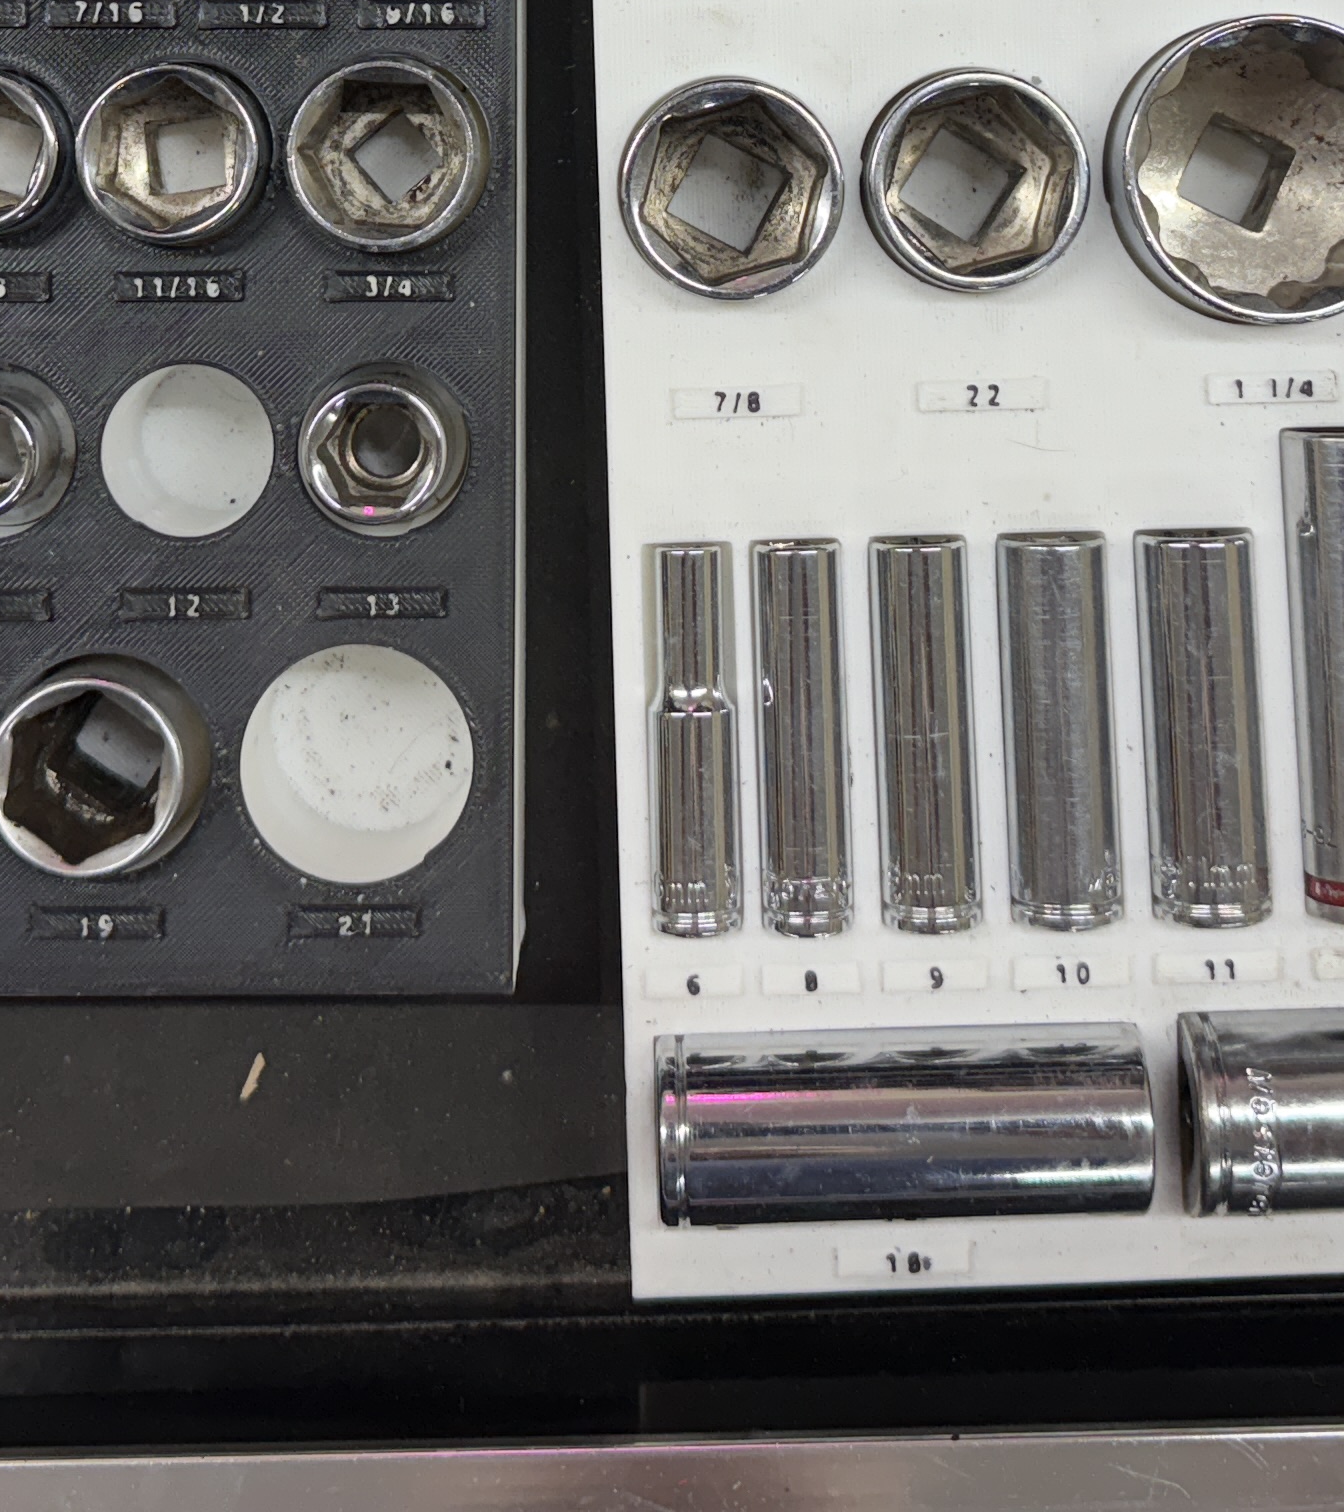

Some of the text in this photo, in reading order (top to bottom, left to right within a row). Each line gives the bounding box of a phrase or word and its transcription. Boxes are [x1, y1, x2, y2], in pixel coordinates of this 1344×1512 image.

[715, 392, 760, 413] 7/8
[967, 384, 999, 407] 22
[930, 967, 944, 989] 9
[1057, 963, 1089, 985] 10
[1205, 959, 1235, 980] 11
[687, 975, 700, 996] 6
